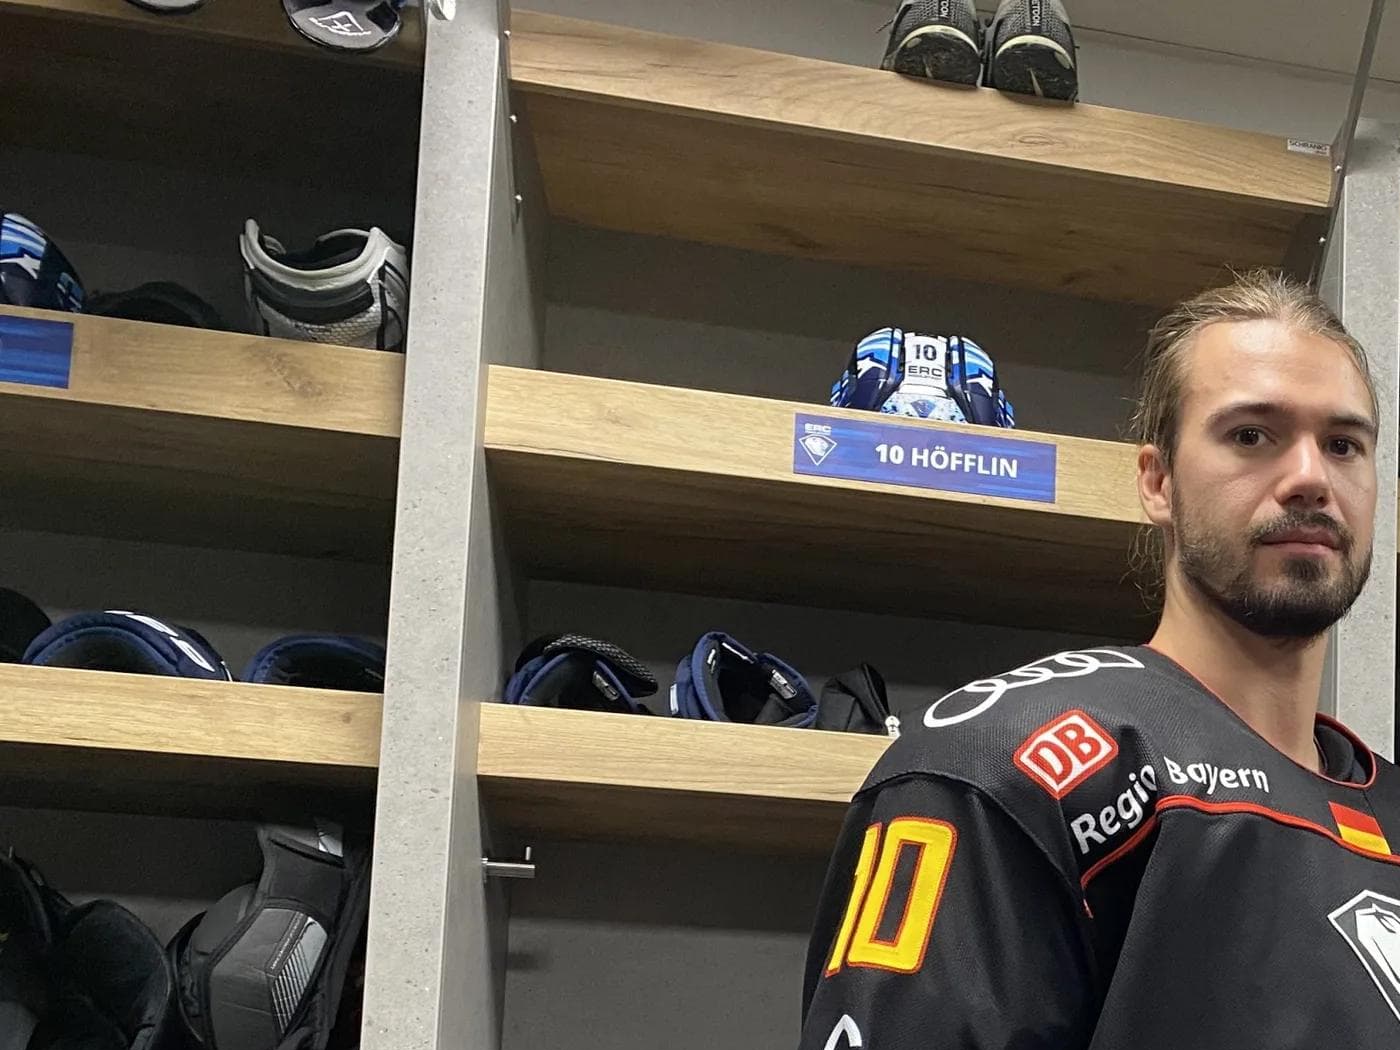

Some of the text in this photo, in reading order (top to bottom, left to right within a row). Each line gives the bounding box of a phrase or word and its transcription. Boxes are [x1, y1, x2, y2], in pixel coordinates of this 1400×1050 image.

[913, 344, 937, 361] 10
[908, 365, 943, 377] ERC
[804, 423, 832, 434] ERC
[876, 443, 1018, 478] 10 HÖFFLIN
[1027, 722, 1101, 786] DB
[1070, 756, 1270, 855] Regio Bayern
[825, 815, 959, 978] 10
